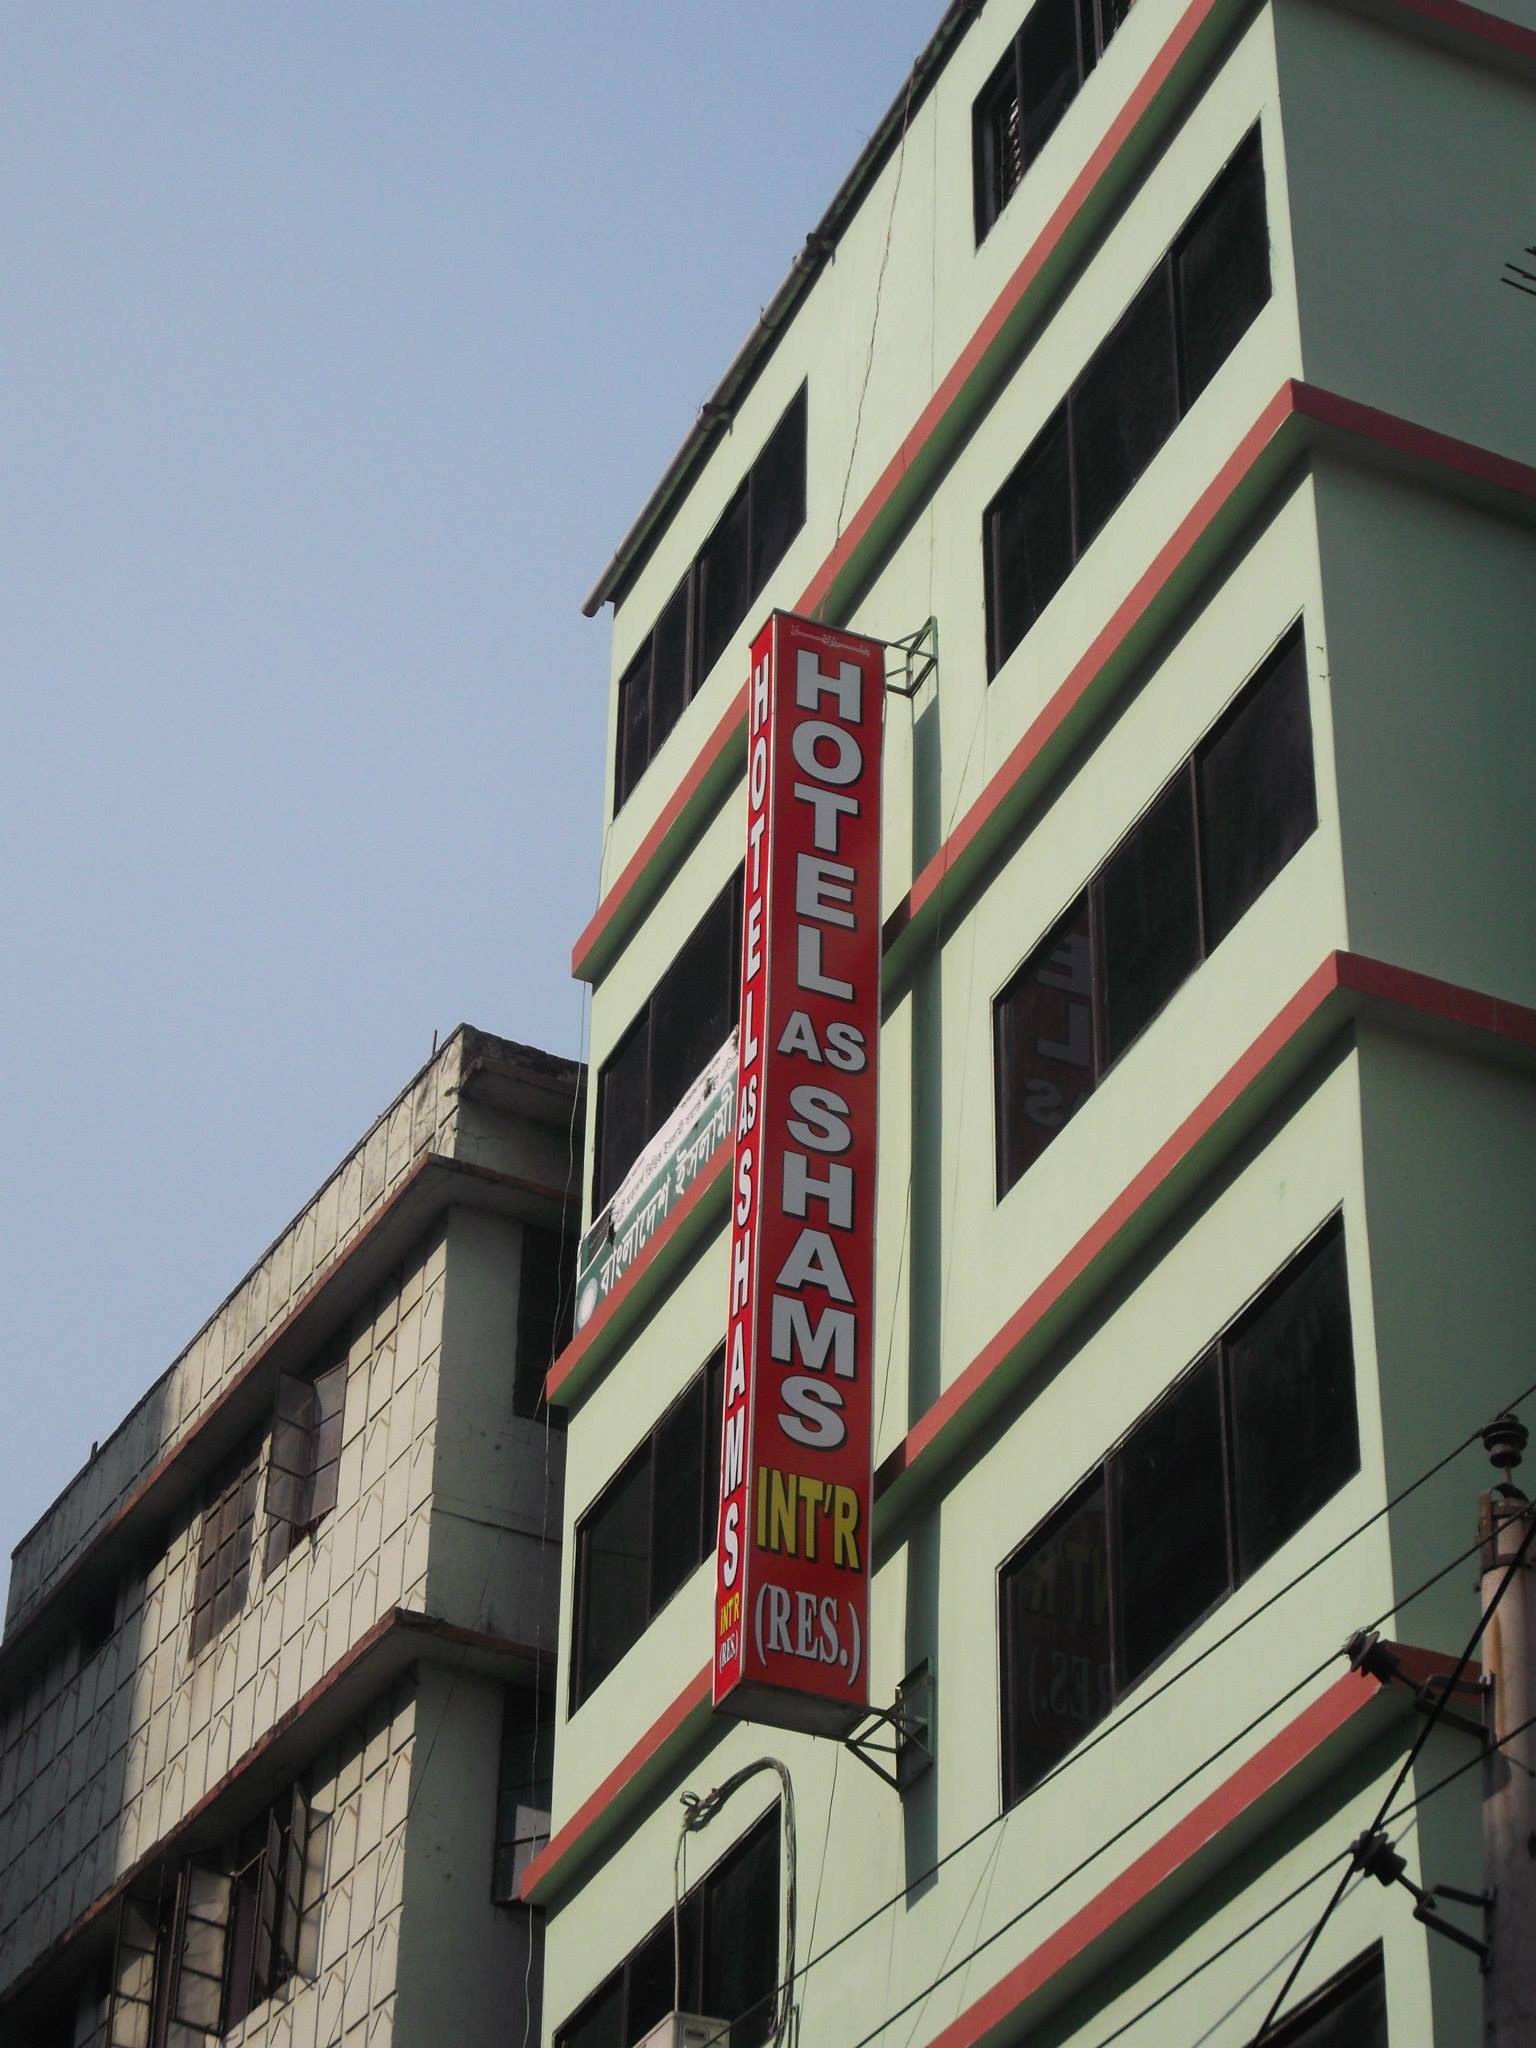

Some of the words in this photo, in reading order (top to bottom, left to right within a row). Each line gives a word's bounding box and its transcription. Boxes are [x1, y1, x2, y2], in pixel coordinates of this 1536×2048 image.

[744, 653, 770, 1069] HOTEL
[792, 648, 863, 1001] HOTEL
[738, 1073, 758, 1143] AS
[776, 1010, 867, 1072] AS
[599, 1176, 671, 1297] বাংলাদেশ
[675, 1080, 735, 1196] ইসলামী
[771, 1084, 856, 1449] SHAMS
[723, 1147, 753, 1588] SHAMS
[757, 1465, 860, 1570] INT'R
[754, 1582, 862, 1686] (RES.)
